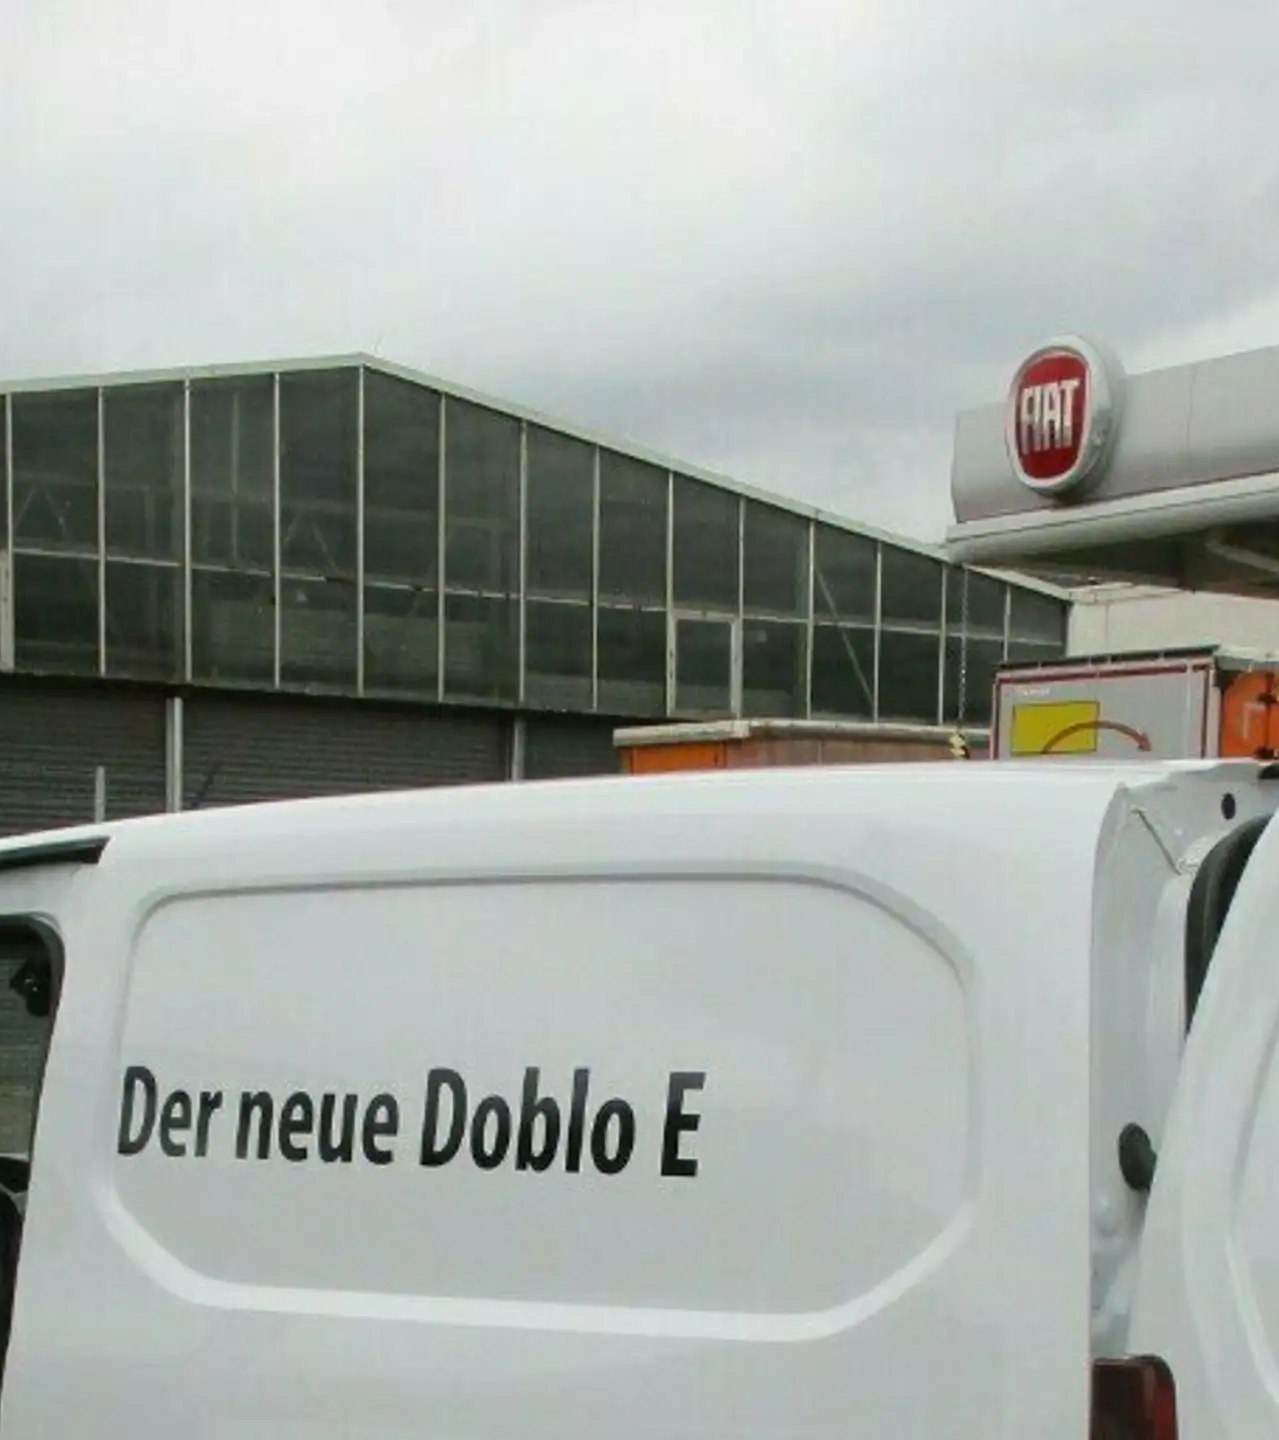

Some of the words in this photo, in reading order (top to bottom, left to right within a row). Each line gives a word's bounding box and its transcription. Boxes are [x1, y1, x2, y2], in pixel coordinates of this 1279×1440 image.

[1019, 378, 1082, 455] FIAT
[117, 1065, 223, 1158] Der
[235, 1089, 401, 1166] neue
[420, 1066, 637, 1177] Doblo
[660, 1070, 707, 1178] E
